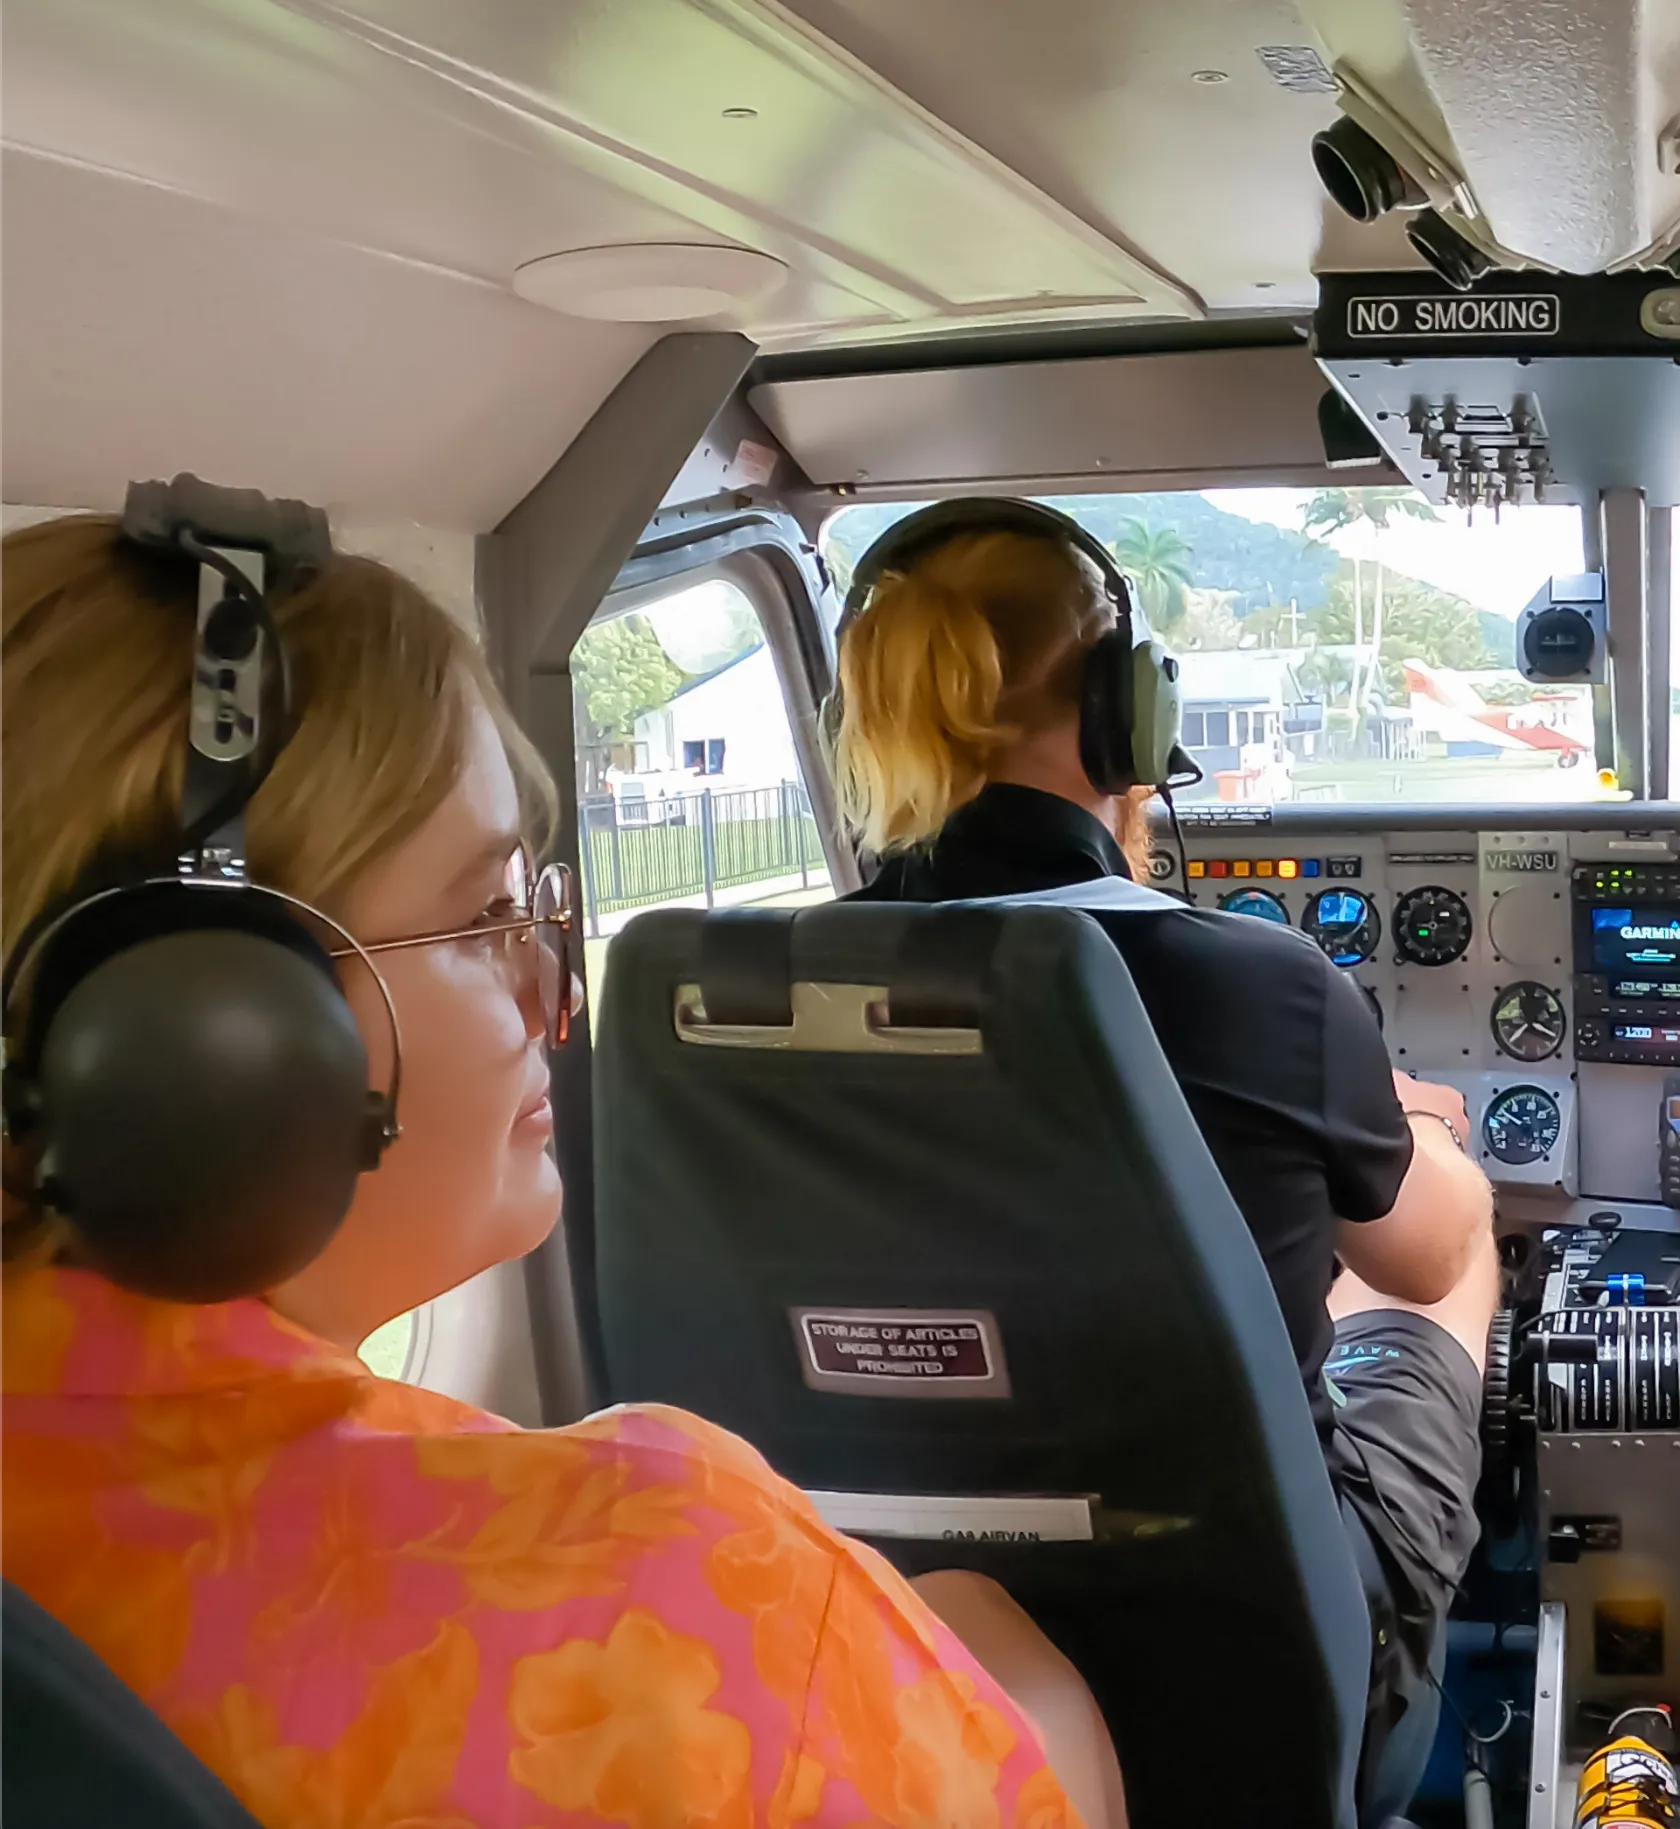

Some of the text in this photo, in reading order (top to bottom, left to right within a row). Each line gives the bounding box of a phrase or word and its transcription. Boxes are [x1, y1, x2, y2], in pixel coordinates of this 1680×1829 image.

[1357, 300, 1550, 331] NO SMOKING
[1487, 853, 1557, 870] VH-WSU
[811, 1323, 978, 1341] STORAGE OF ARTICLES
[836, 1342, 958, 1357] UNDER SEATS IS
[857, 1359, 943, 1374] PROHIBITED
